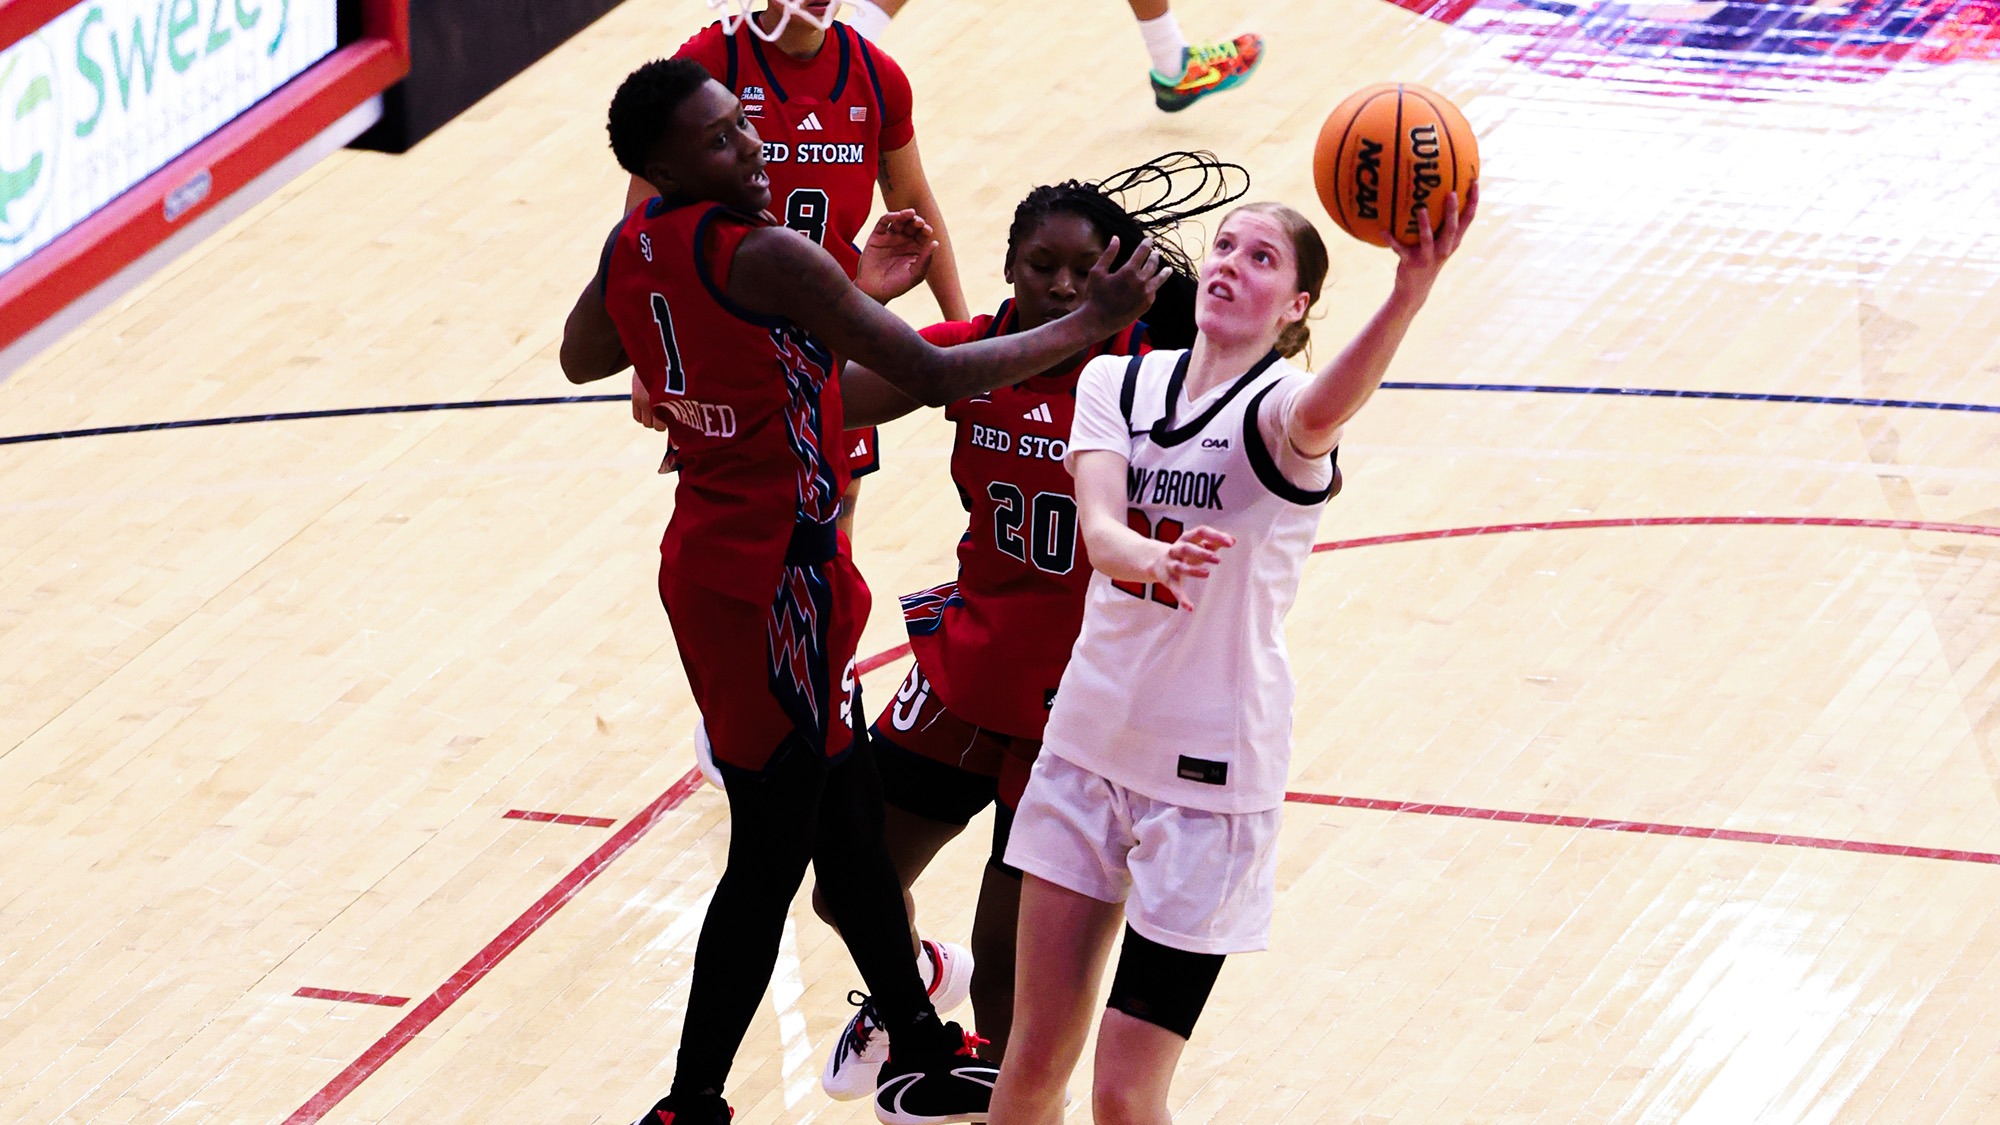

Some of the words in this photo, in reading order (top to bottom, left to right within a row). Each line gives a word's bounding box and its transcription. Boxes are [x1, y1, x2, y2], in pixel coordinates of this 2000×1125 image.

[744, 104, 764, 112] BIG
[762, 142, 790, 162] ED
[797, 143, 864, 163] STORM
[1355, 138, 1384, 220] NCAA
[785, 188, 829, 246] 8
[650, 292, 686, 396] 1
[971, 424, 1011, 452] RED
[1018, 435, 1068, 461] STO
[1201, 438, 1229, 449] CAA
[1127, 465, 1155, 504] NY
[1151, 469, 1227, 511] BROOK
[986, 481, 1078, 575] 20
